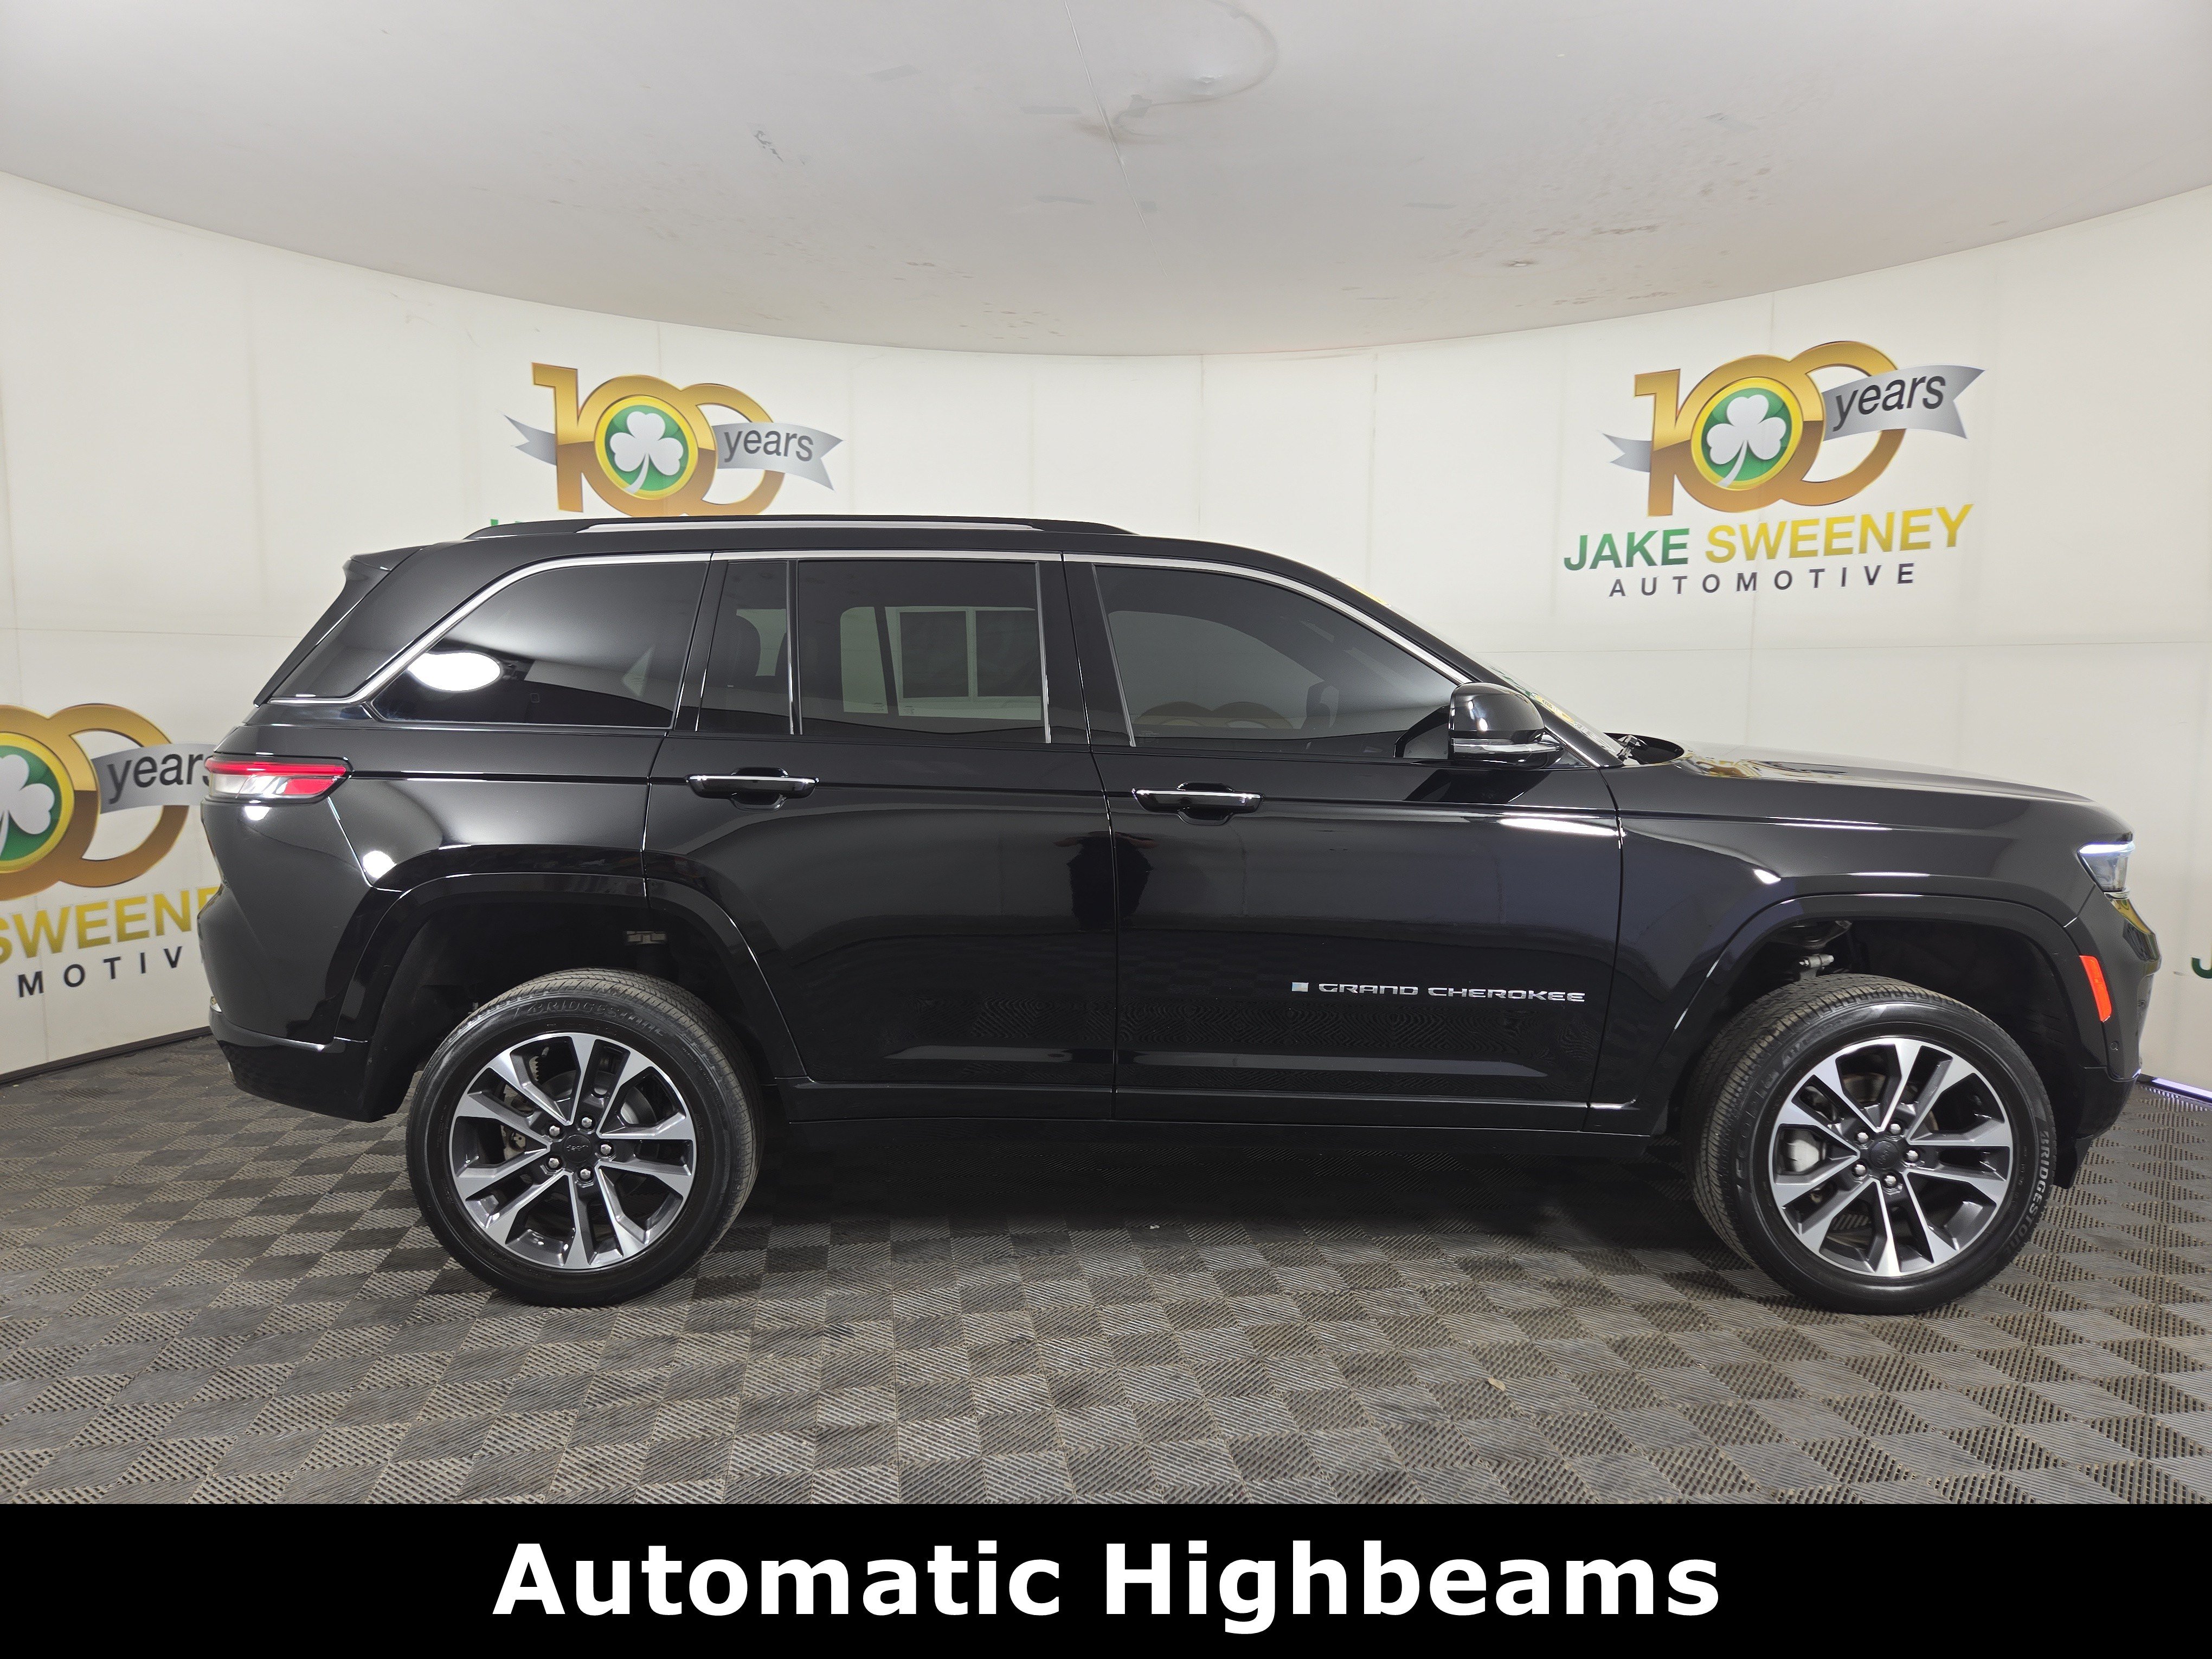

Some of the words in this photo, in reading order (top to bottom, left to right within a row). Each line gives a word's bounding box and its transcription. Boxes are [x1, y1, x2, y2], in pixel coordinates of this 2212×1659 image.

[531, 362, 786, 517] 100
[723, 430, 813, 462] years
[1634, 340, 1907, 517] 100
[1832, 375, 1946, 432] years
[1564, 528, 1690, 571] JAKE
[1706, 504, 1974, 564] SWEENEY
[1609, 563, 1914, 597] AUTOMOTIVE
[1319, 983, 1418, 995] GRAND
[1427, 987, 1585, 1002] CHEROKEE
[2002, 1130, 2050, 1257] BRIDGESTONE
